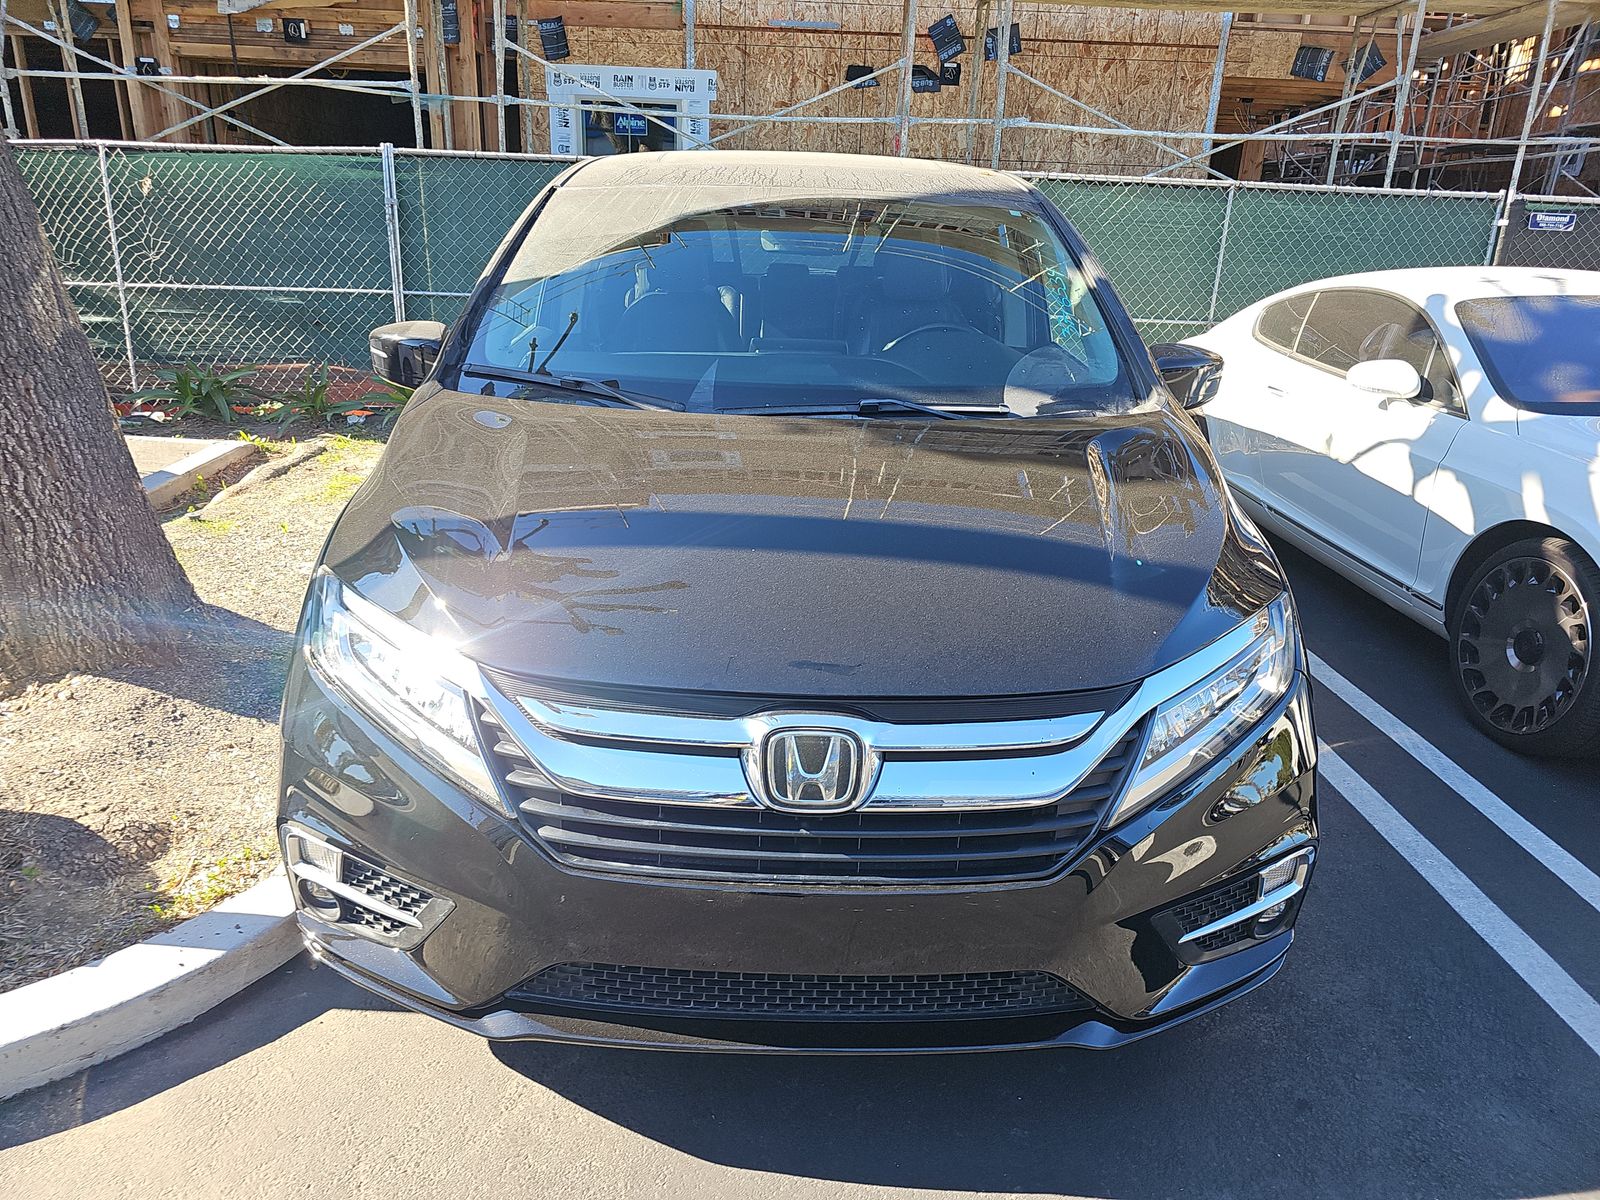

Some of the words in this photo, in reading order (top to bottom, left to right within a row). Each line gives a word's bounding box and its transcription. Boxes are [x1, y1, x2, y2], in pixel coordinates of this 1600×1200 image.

[613, 74, 634, 83] RAIN
[674, 84, 695, 92] RAIN
[616, 115, 646, 129] Alpine
[1536, 214, 1570, 222] Diamond
